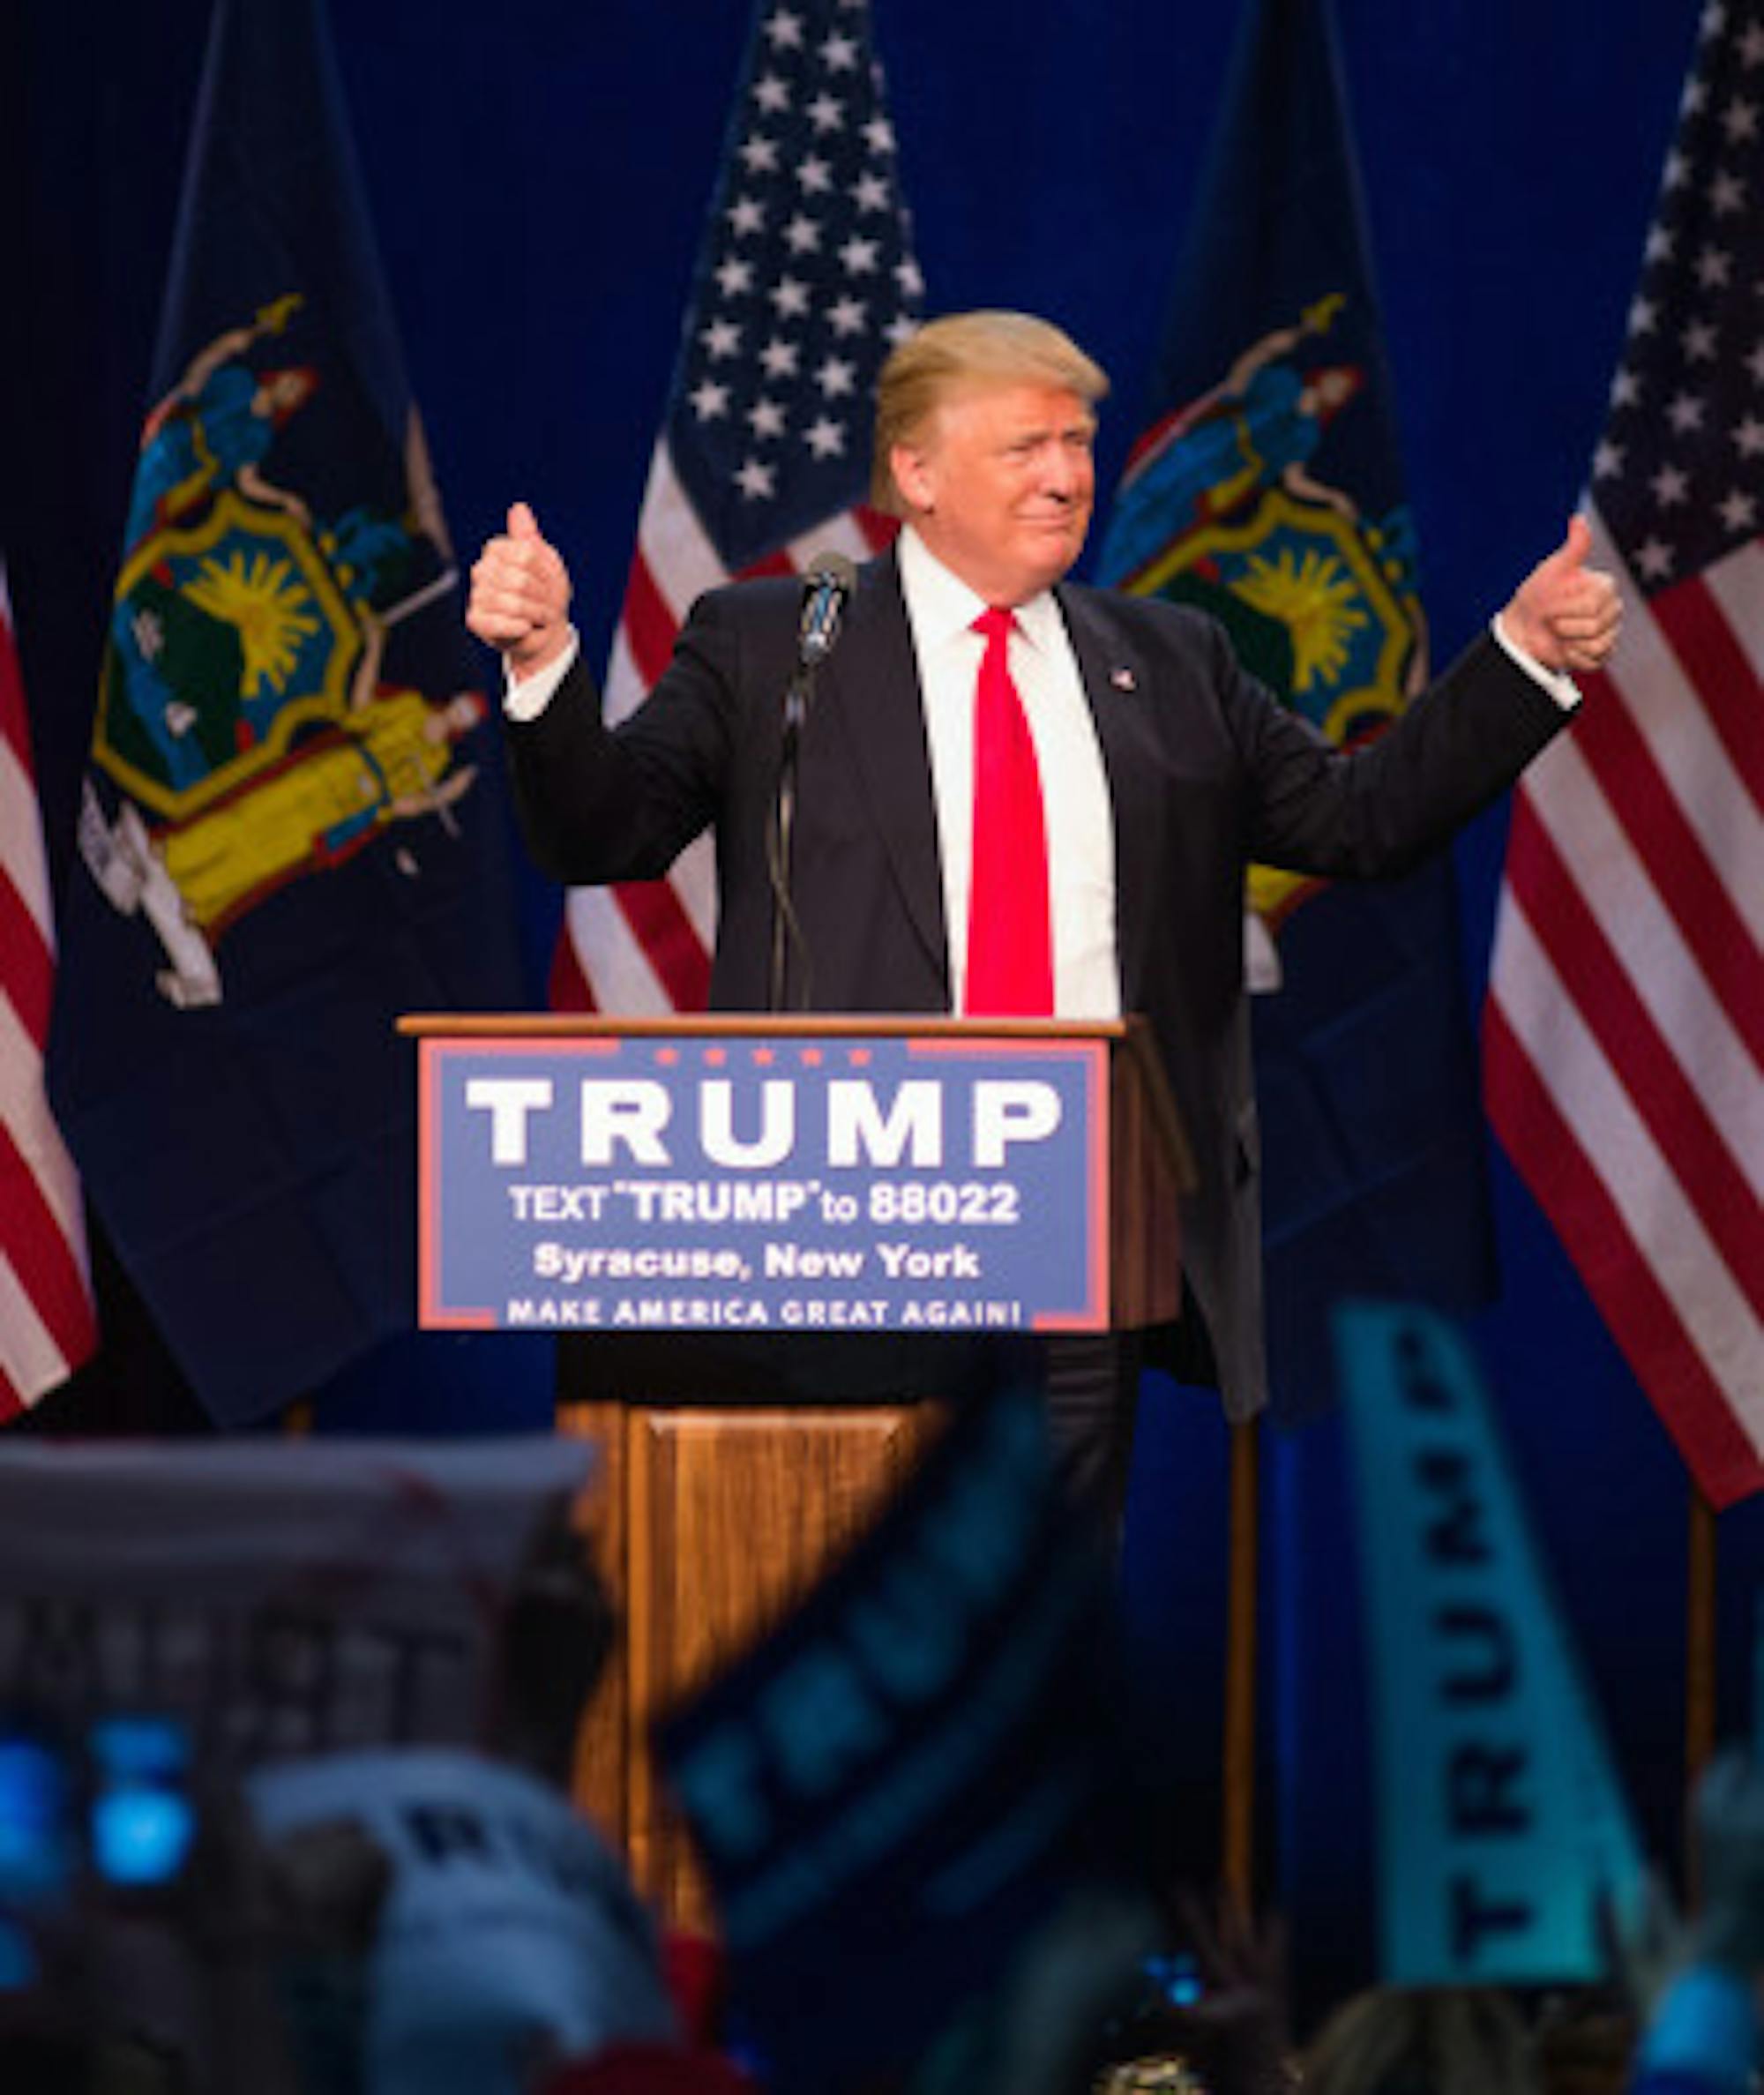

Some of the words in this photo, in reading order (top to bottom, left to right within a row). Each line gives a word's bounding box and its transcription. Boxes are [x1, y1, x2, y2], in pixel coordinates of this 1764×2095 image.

[465, 1078, 1063, 1168] TRUMP
[507, 1184, 609, 1222] TEXT
[820, 1189, 859, 1223] to
[869, 1181, 1020, 1225] 88022
[533, 1242, 752, 1284] Syracuse,
[764, 1242, 864, 1278] New
[876, 1242, 982, 1279] York
[506, 1298, 602, 1325] MAKE
[613, 1298, 768, 1325] AMERICA
[780, 1299, 889, 1325] GREAT
[901, 1299, 1021, 1326] AGAIN!
[1391, 1322, 1537, 1969] TRUMP
